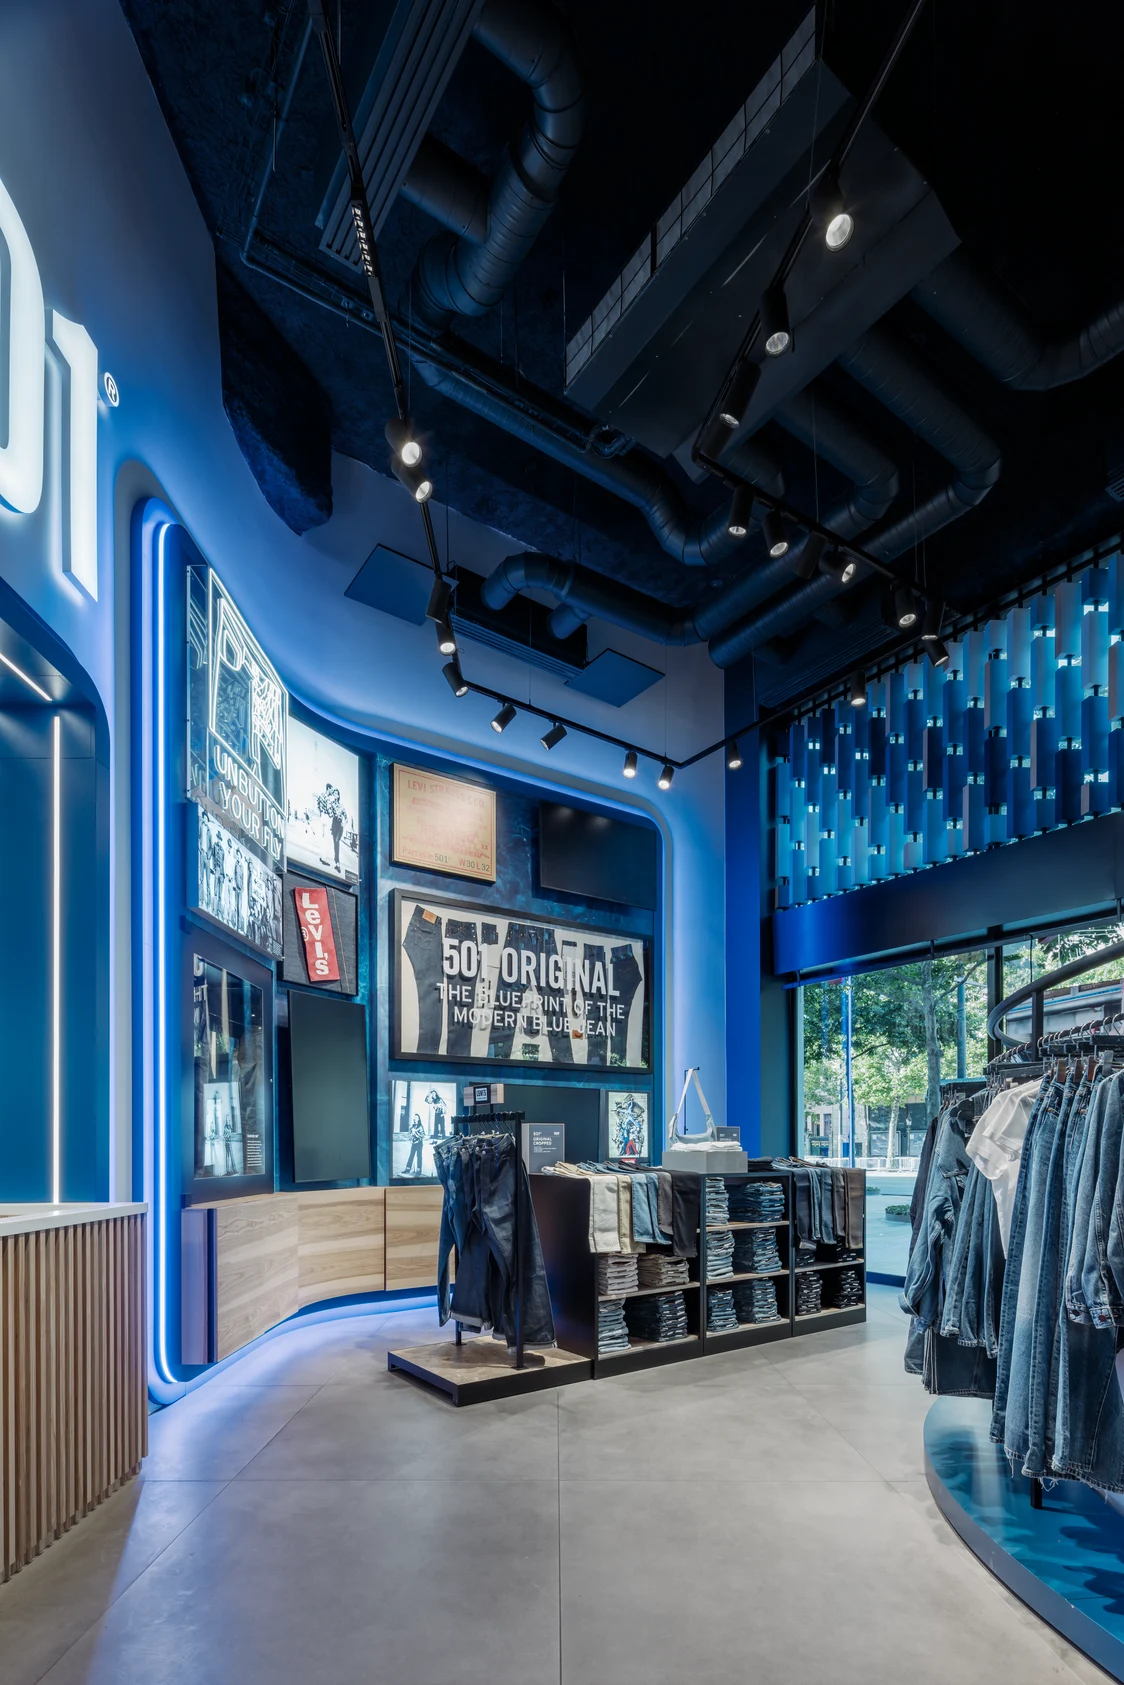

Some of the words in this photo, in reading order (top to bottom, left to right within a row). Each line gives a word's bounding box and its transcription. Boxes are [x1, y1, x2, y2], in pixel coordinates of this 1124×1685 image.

[214, 745, 284, 839] UNBUTTON
[407, 780, 426, 793] LEVI
[220, 782, 260, 839] YOUR
[261, 826, 282, 860] FLY
[442, 938, 489, 979] 501
[501, 947, 620, 997] ORIGINAL
[436, 983, 472, 1003] THE
[478, 988, 568, 1013] BLUEPRINT
[573, 1000, 593, 1015] OF
[597, 1002, 625, 1019] THE
[454, 1007, 527, 1030] MODERN
[533, 1015, 572, 1033] BLUE
[577, 1019, 616, 1037] JEAN
